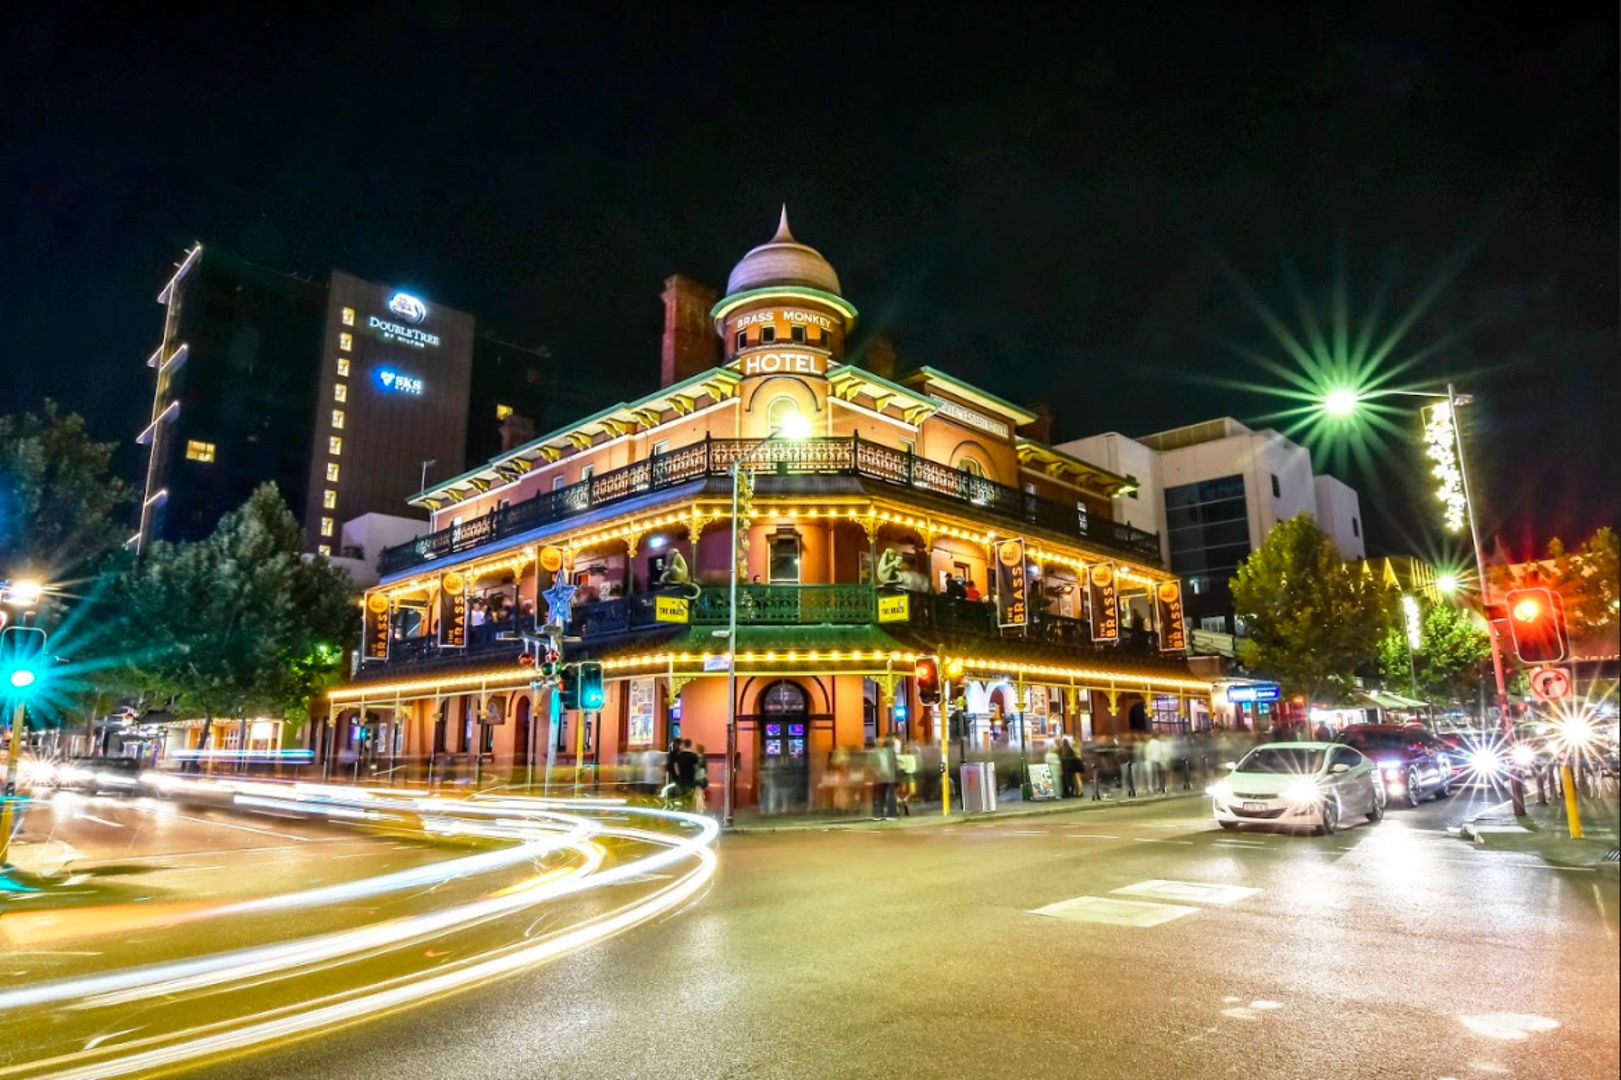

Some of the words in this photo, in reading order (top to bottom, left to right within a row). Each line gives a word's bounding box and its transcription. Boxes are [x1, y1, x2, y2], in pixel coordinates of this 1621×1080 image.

[737, 312, 774, 328] BRASS
[783, 311, 831, 328] MONKEY
[746, 353, 823, 375] HOTEL
[1012, 566, 1024, 622] BRASS
[1103, 587, 1116, 637] BRASS
[377, 614, 387, 657] BRASS
[454, 596, 464, 644] BRASS
[1170, 602, 1184, 648] BRASS
